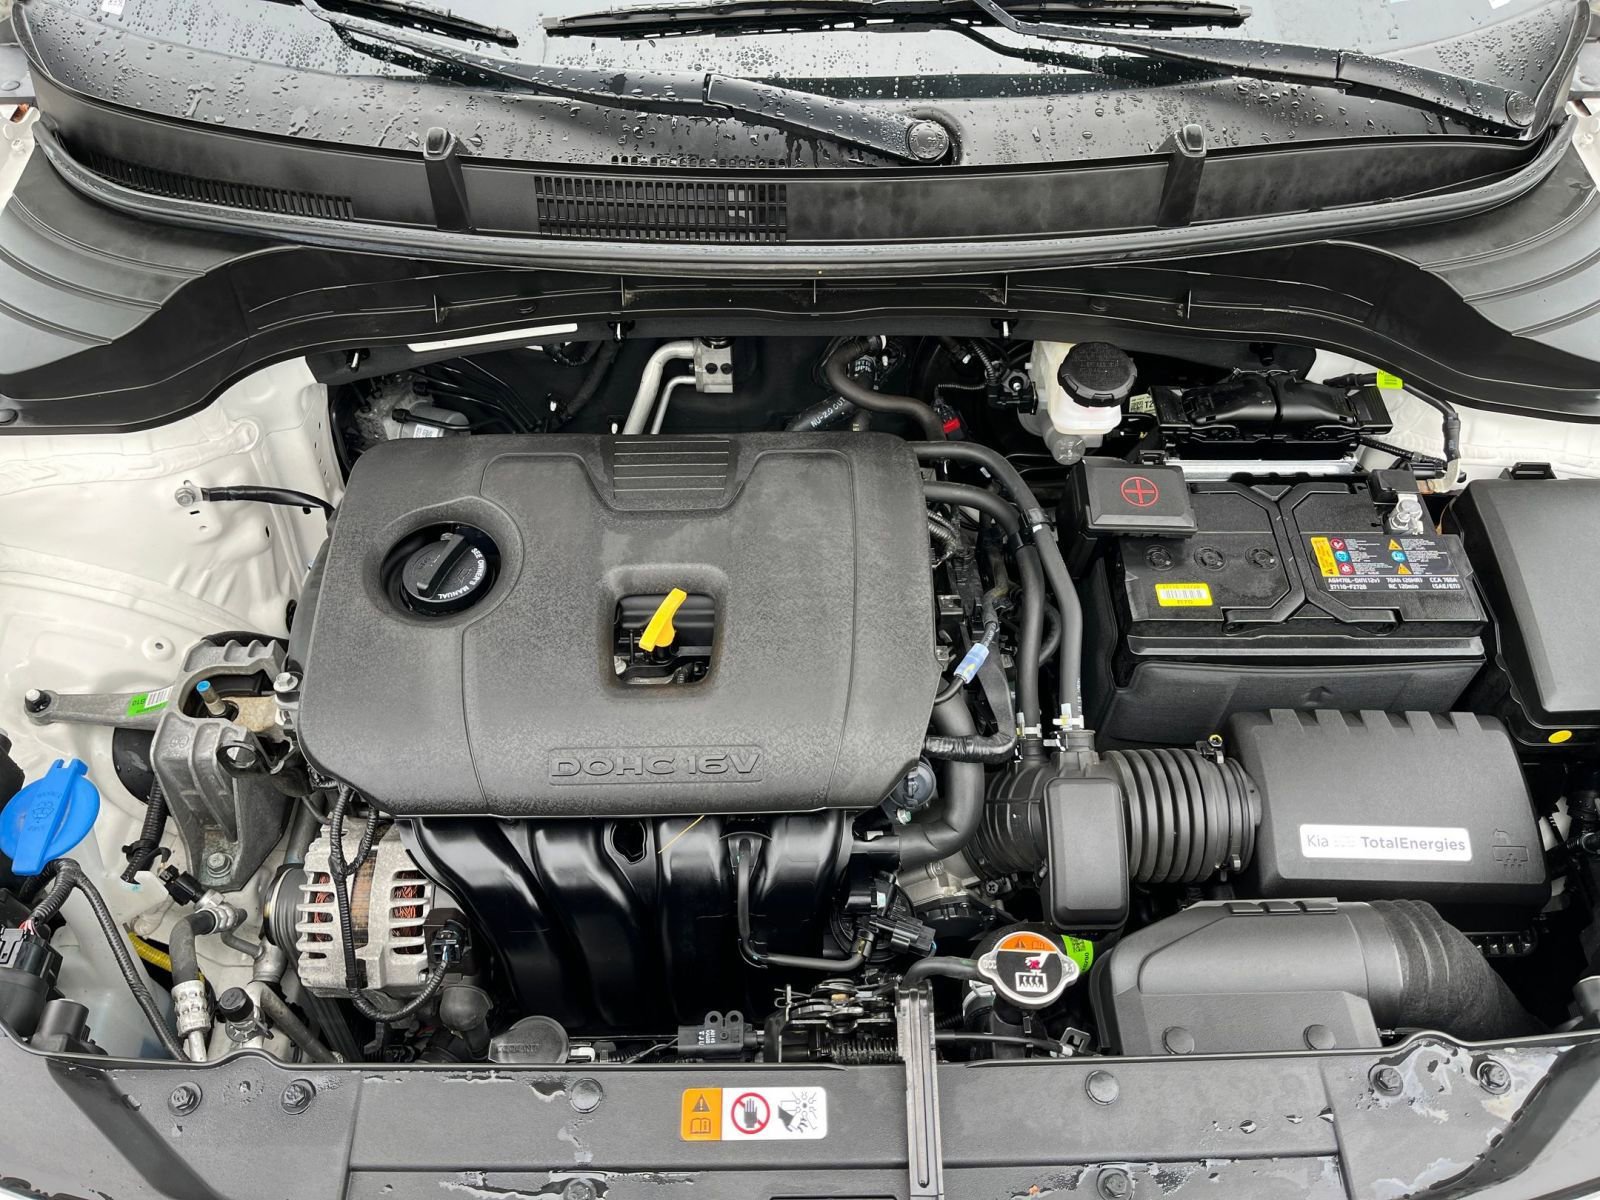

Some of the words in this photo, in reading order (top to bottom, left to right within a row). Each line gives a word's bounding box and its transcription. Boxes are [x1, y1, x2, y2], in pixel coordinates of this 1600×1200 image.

[471, 547, 482, 559] SEE
[469, 559, 485, 586] OWNER'S
[438, 585, 470, 599] MANUAL
[551, 756, 675, 776] DOHC
[687, 753, 760, 774] 16V
[1306, 834, 1329, 848] Kia
[1360, 836, 1466, 853] TotalEnergies
